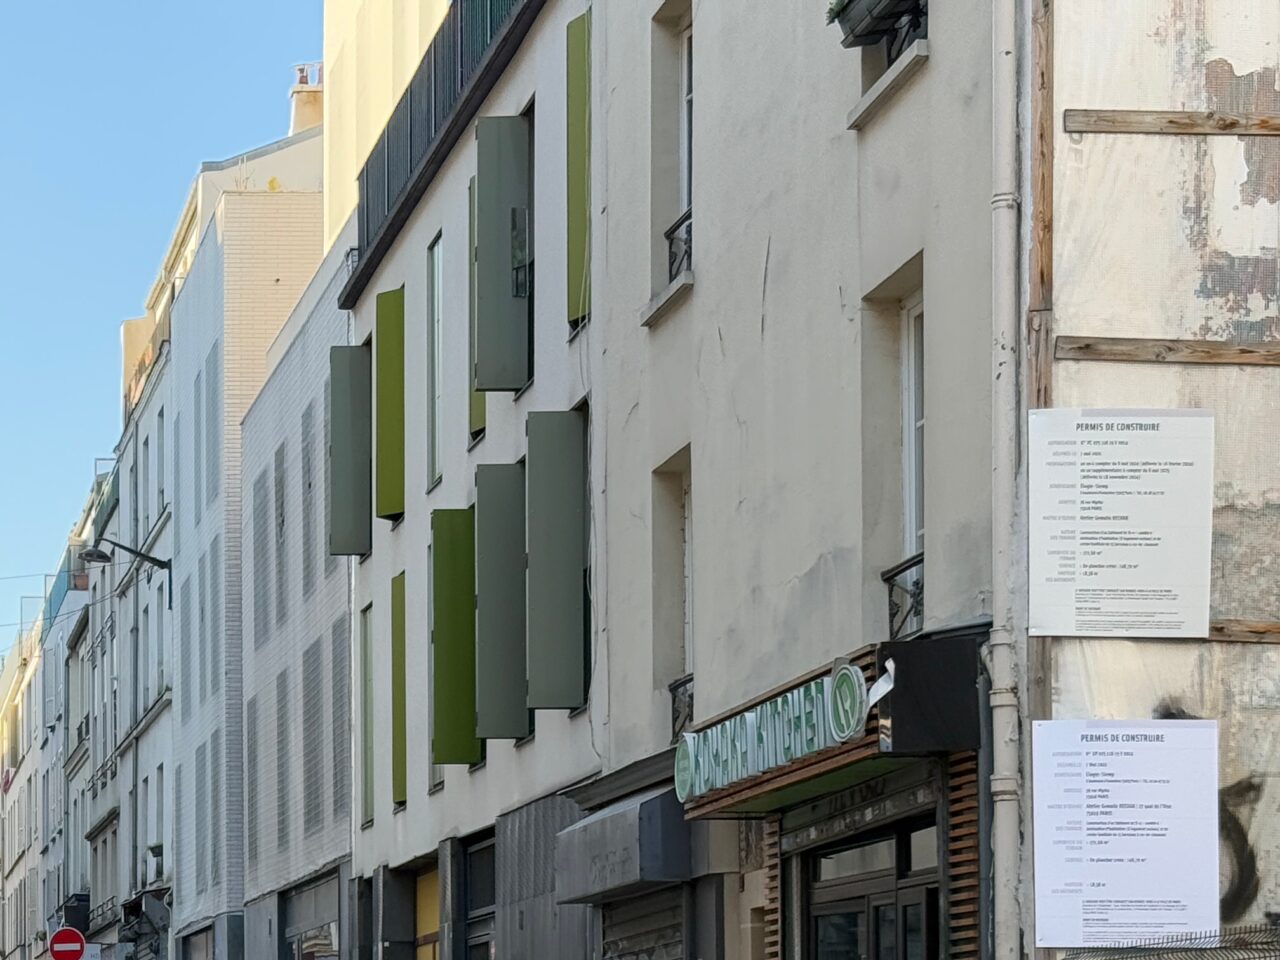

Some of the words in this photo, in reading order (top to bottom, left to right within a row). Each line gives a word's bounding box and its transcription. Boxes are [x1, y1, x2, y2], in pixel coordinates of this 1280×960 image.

[1076, 423, 1104, 432] PERMIS
[1106, 423, 1114, 432] DE
[1116, 423, 1161, 432] CONSTRUIRE
[1080, 734, 1109, 743] PERMIS
[1110, 734, 1120, 743] DE
[1121, 734, 1166, 743] CONSTRUIRE
